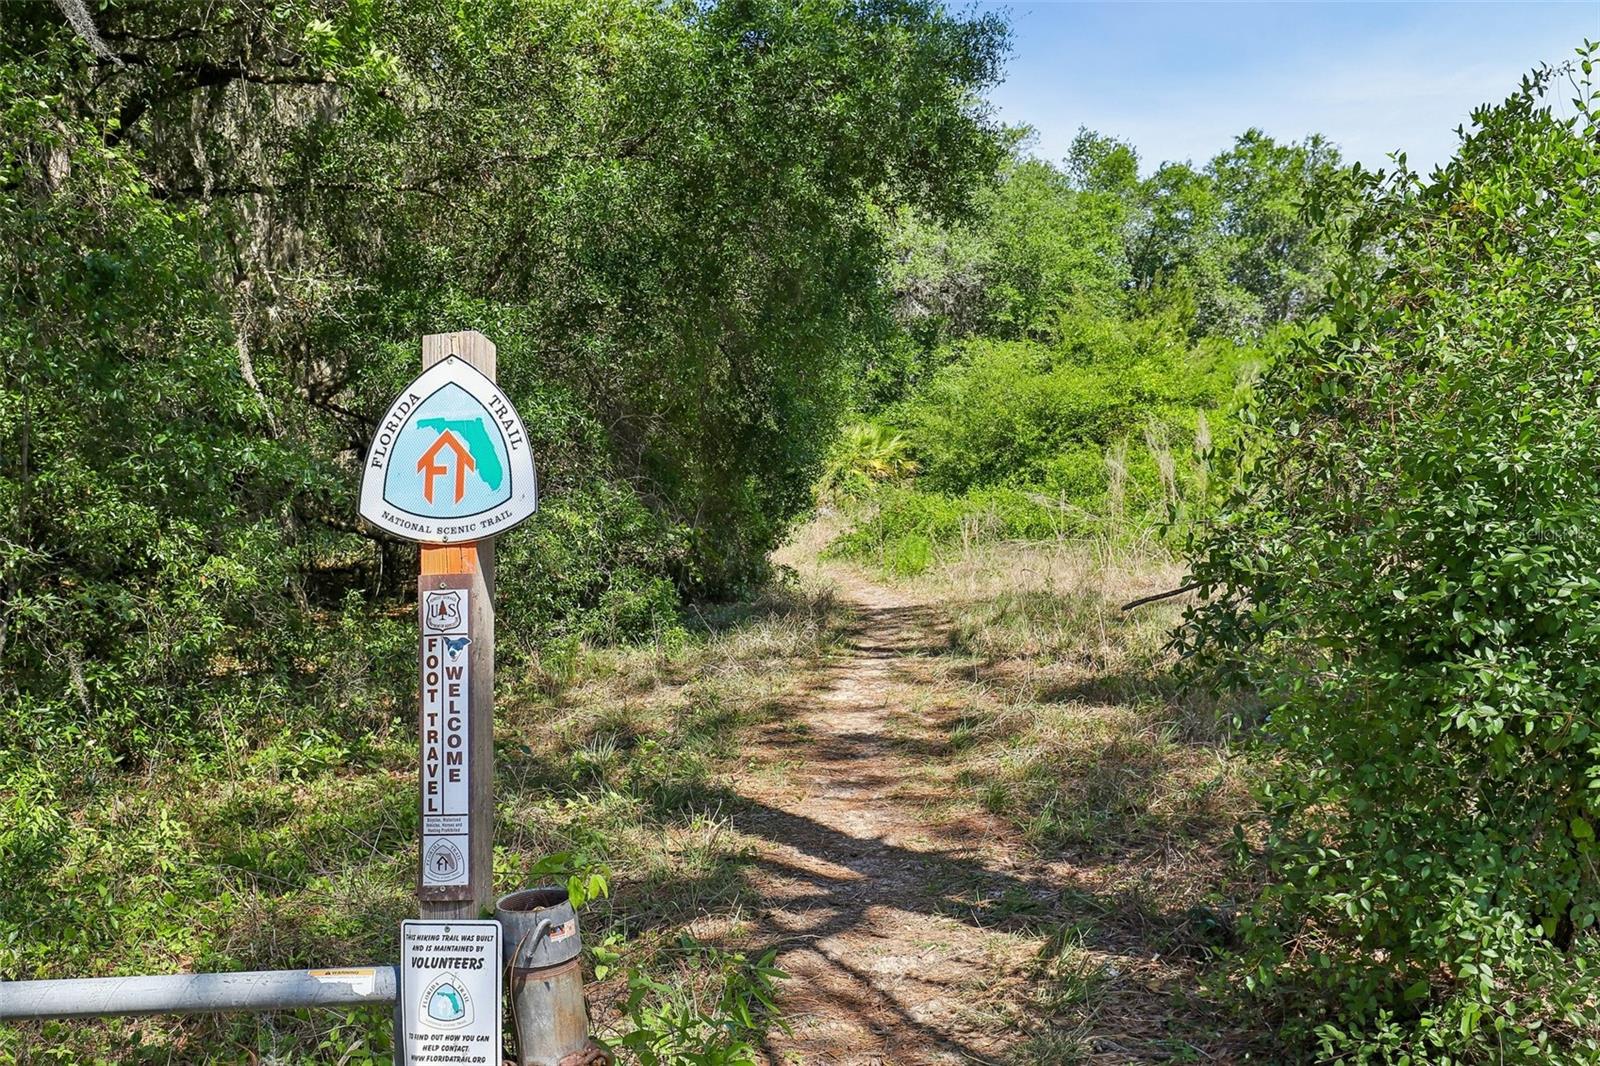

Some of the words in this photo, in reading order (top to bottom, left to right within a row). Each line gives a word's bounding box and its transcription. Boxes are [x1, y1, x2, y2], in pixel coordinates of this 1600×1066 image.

[371, 392, 421, 470] FLORIDA
[488, 394, 523, 451] TRAIL
[381, 510, 432, 534] NATIONAL
[436, 523, 477, 535] SCENIC
[480, 509, 513, 529] TRAIL
[426, 638, 439, 703] FOOT
[445, 666, 464, 783] WELCOME
[426, 712, 439, 812] TRAVEL
[416, 934, 440, 942] HIKING
[433, 945, 475, 953] MAINTAINED
[411, 957, 485, 970] VOLUNTEERS
[422, 982, 440, 1008] FLORIDA
[457, 985, 470, 1003] TRAIL
[414, 1033, 429, 1041] FIND
[445, 1034, 461, 1042] HOW
